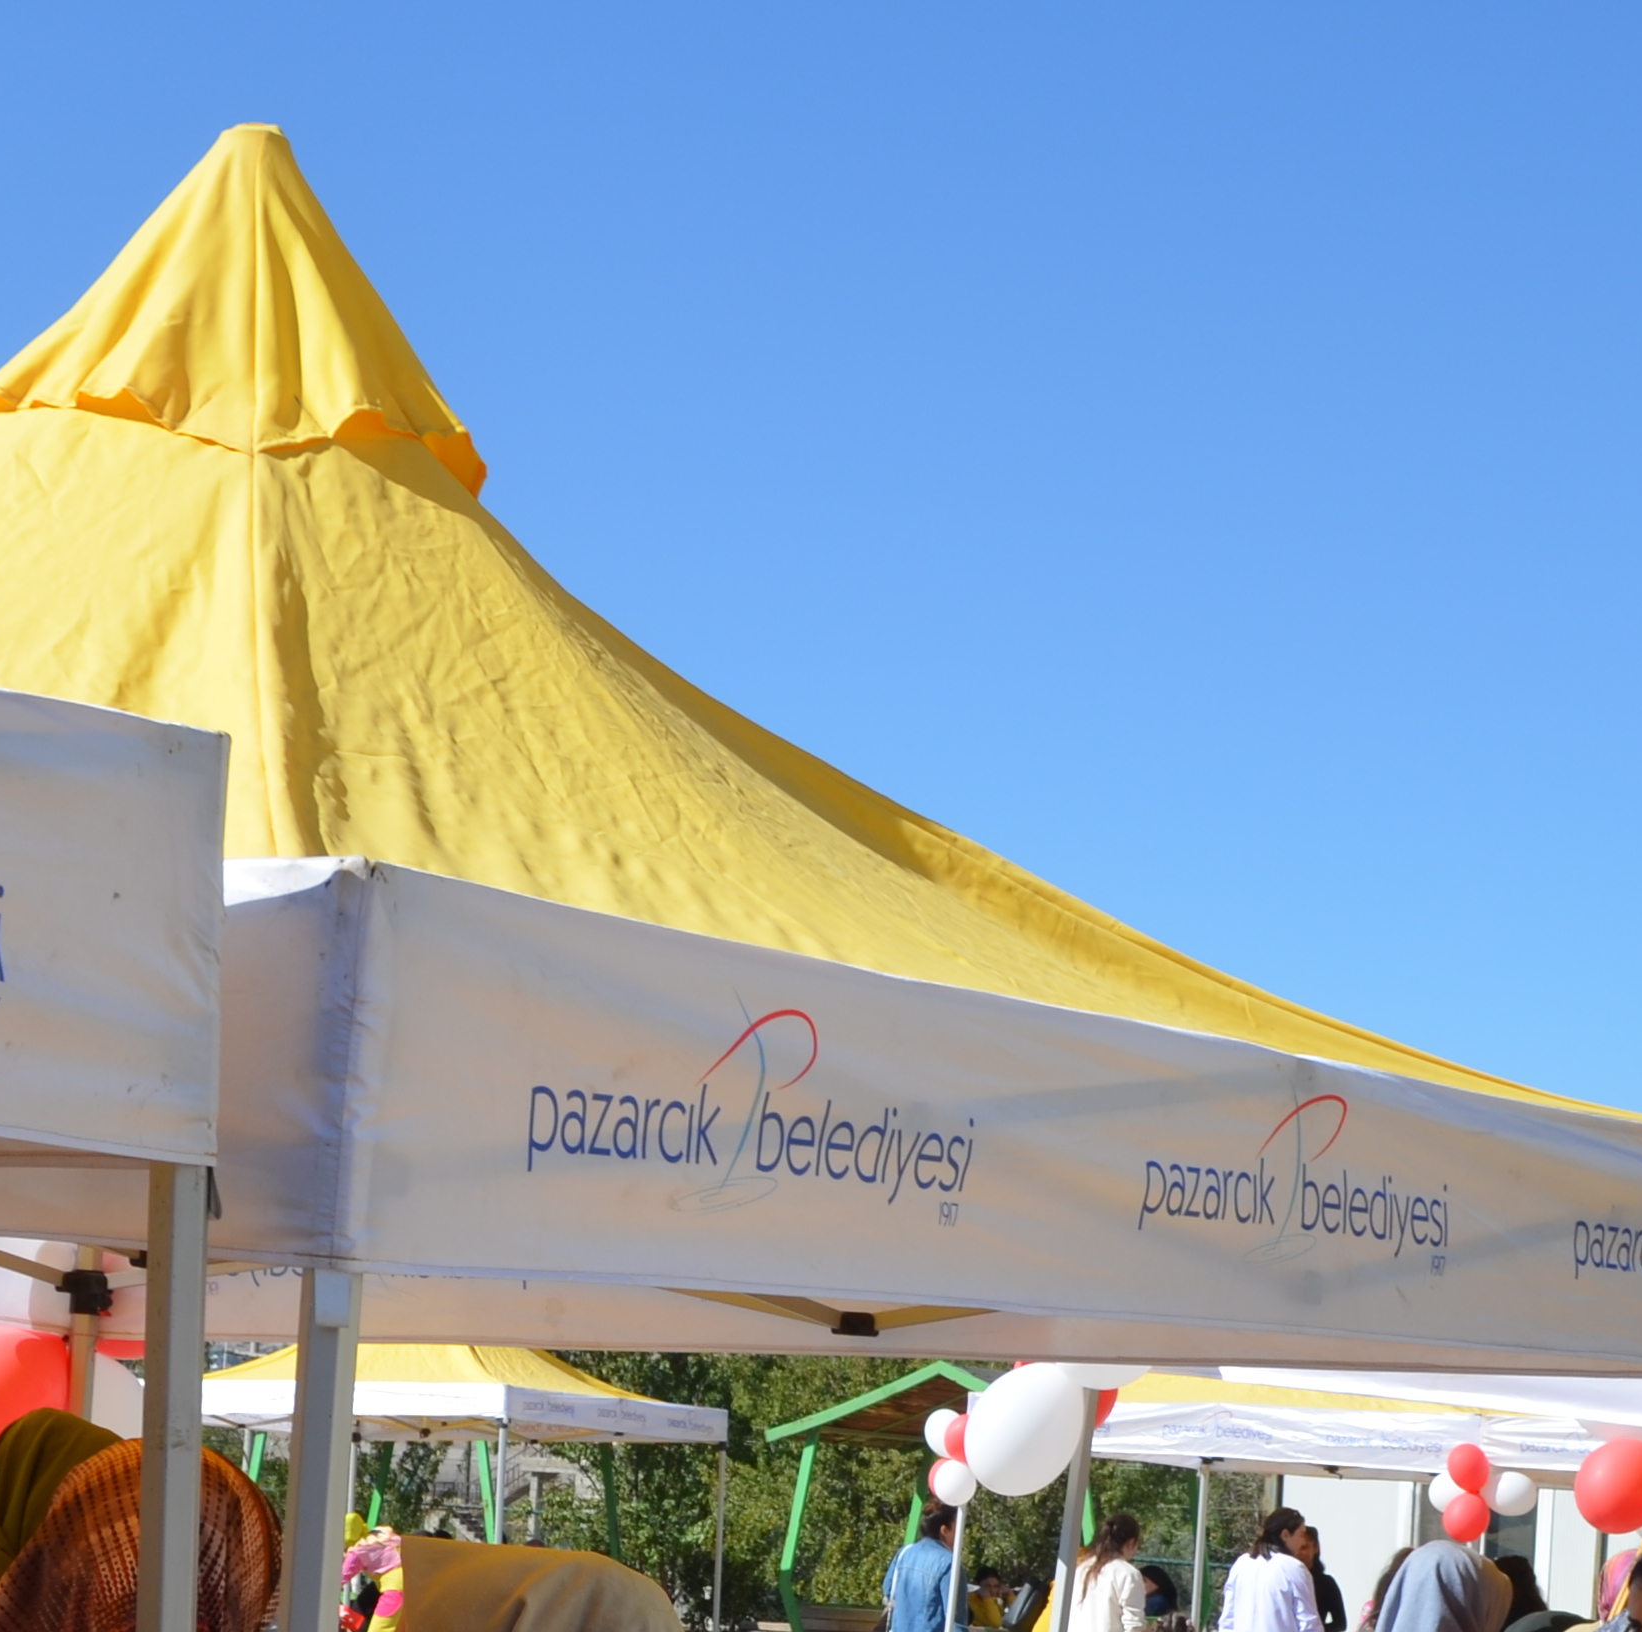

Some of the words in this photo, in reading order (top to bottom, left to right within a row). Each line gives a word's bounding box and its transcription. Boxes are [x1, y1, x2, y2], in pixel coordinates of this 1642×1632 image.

[527, 1083, 721, 1172] pazarcık
[756, 1092, 975, 1205] belediyesi
[938, 1201, 959, 1228] 1917
[1138, 1158, 1275, 1230] pazarcık
[1301, 1163, 1448, 1258] belediyesi
